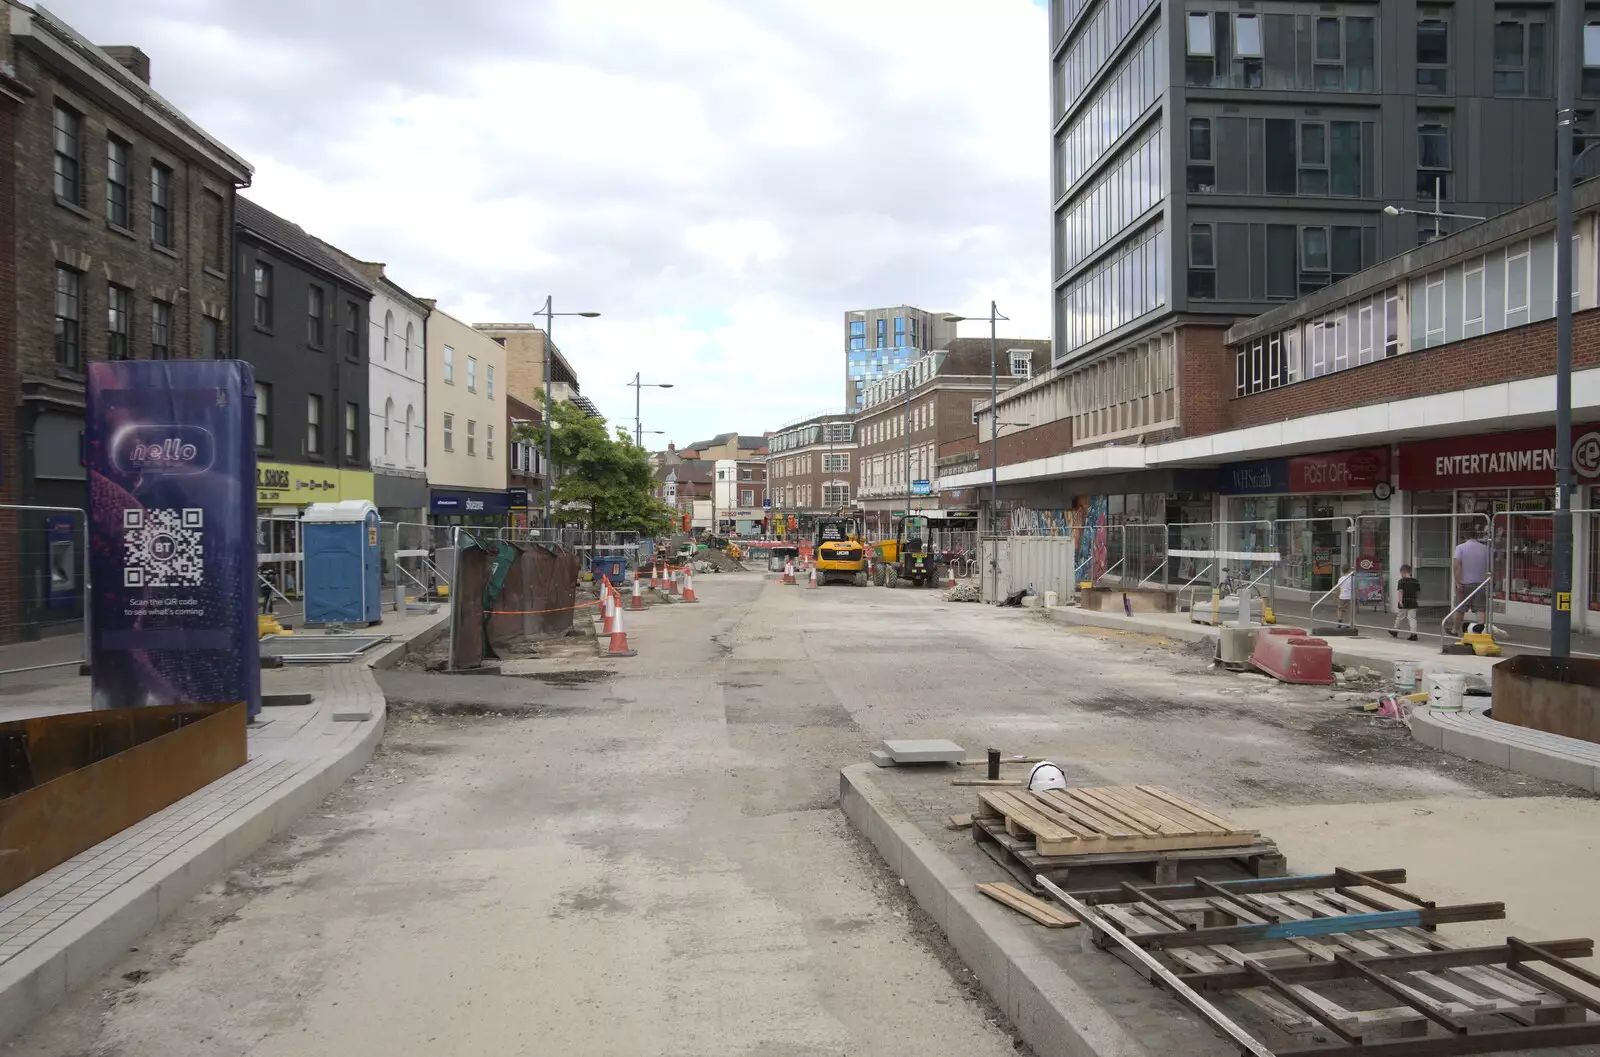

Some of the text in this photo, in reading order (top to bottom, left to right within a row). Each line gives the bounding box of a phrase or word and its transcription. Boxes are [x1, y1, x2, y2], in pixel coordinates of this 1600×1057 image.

[129, 438, 197, 461] hello
[1435, 448, 1557, 476] ENTERTAINMEN
[264, 469, 290, 488] SHOES
[1232, 466, 1272, 490] WHSmith
[1303, 463, 1327, 485] POST
[921, 485, 931, 493] let
[155, 542, 172, 553] BT
[129, 597, 198, 606] Scan the QR code
[1559, 594, 1571, 610] H
[148, 608, 174, 616] what's
[174, 608, 205, 617] coming
